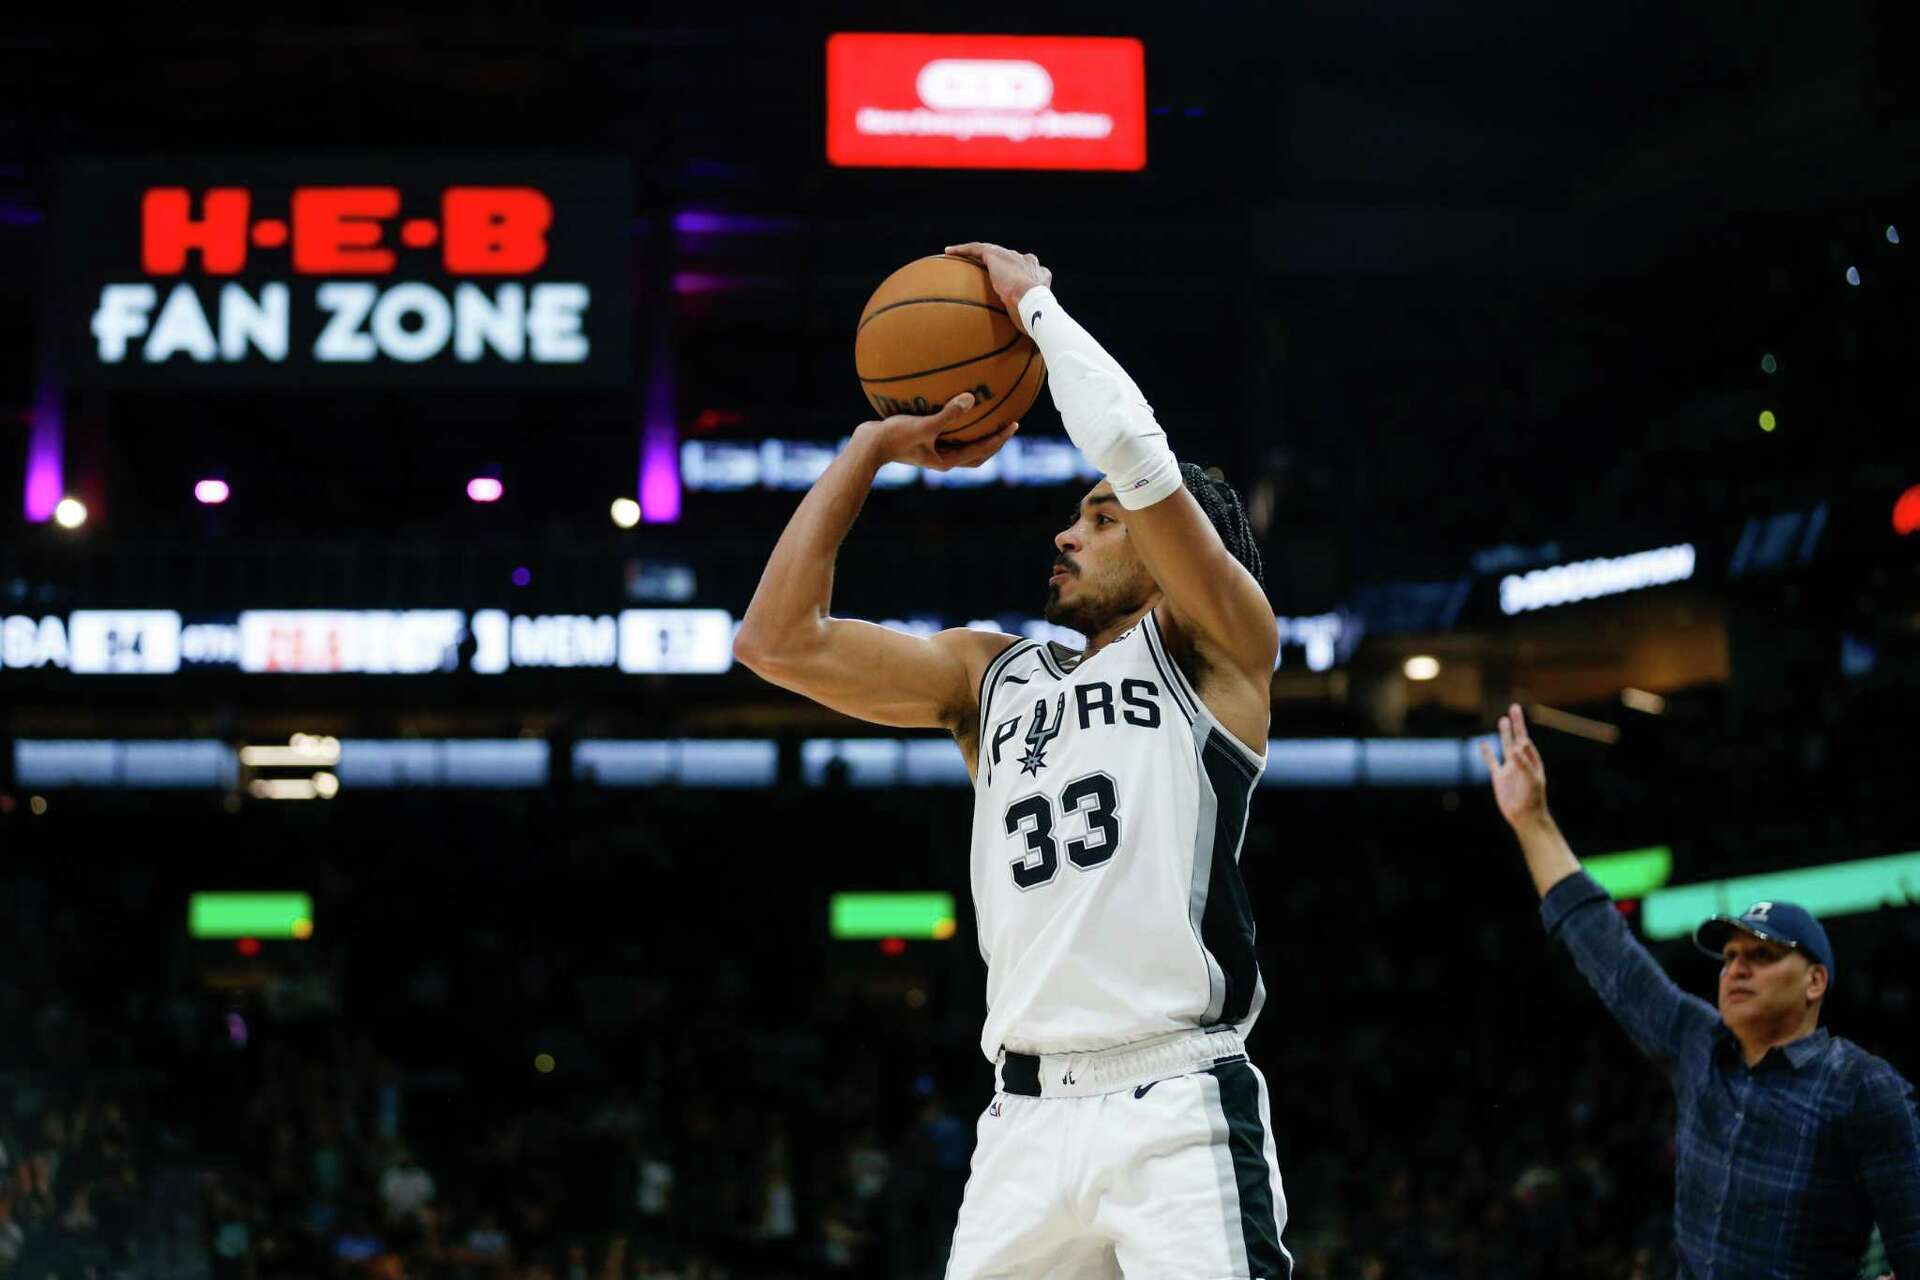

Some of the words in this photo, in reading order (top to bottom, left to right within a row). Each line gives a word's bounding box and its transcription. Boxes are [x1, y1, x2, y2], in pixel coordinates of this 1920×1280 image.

[91, 282, 291, 363] FAN
[313, 282, 590, 363] ZONE
[986, 678, 1161, 787] PURS
[1002, 769, 1122, 893] 33
